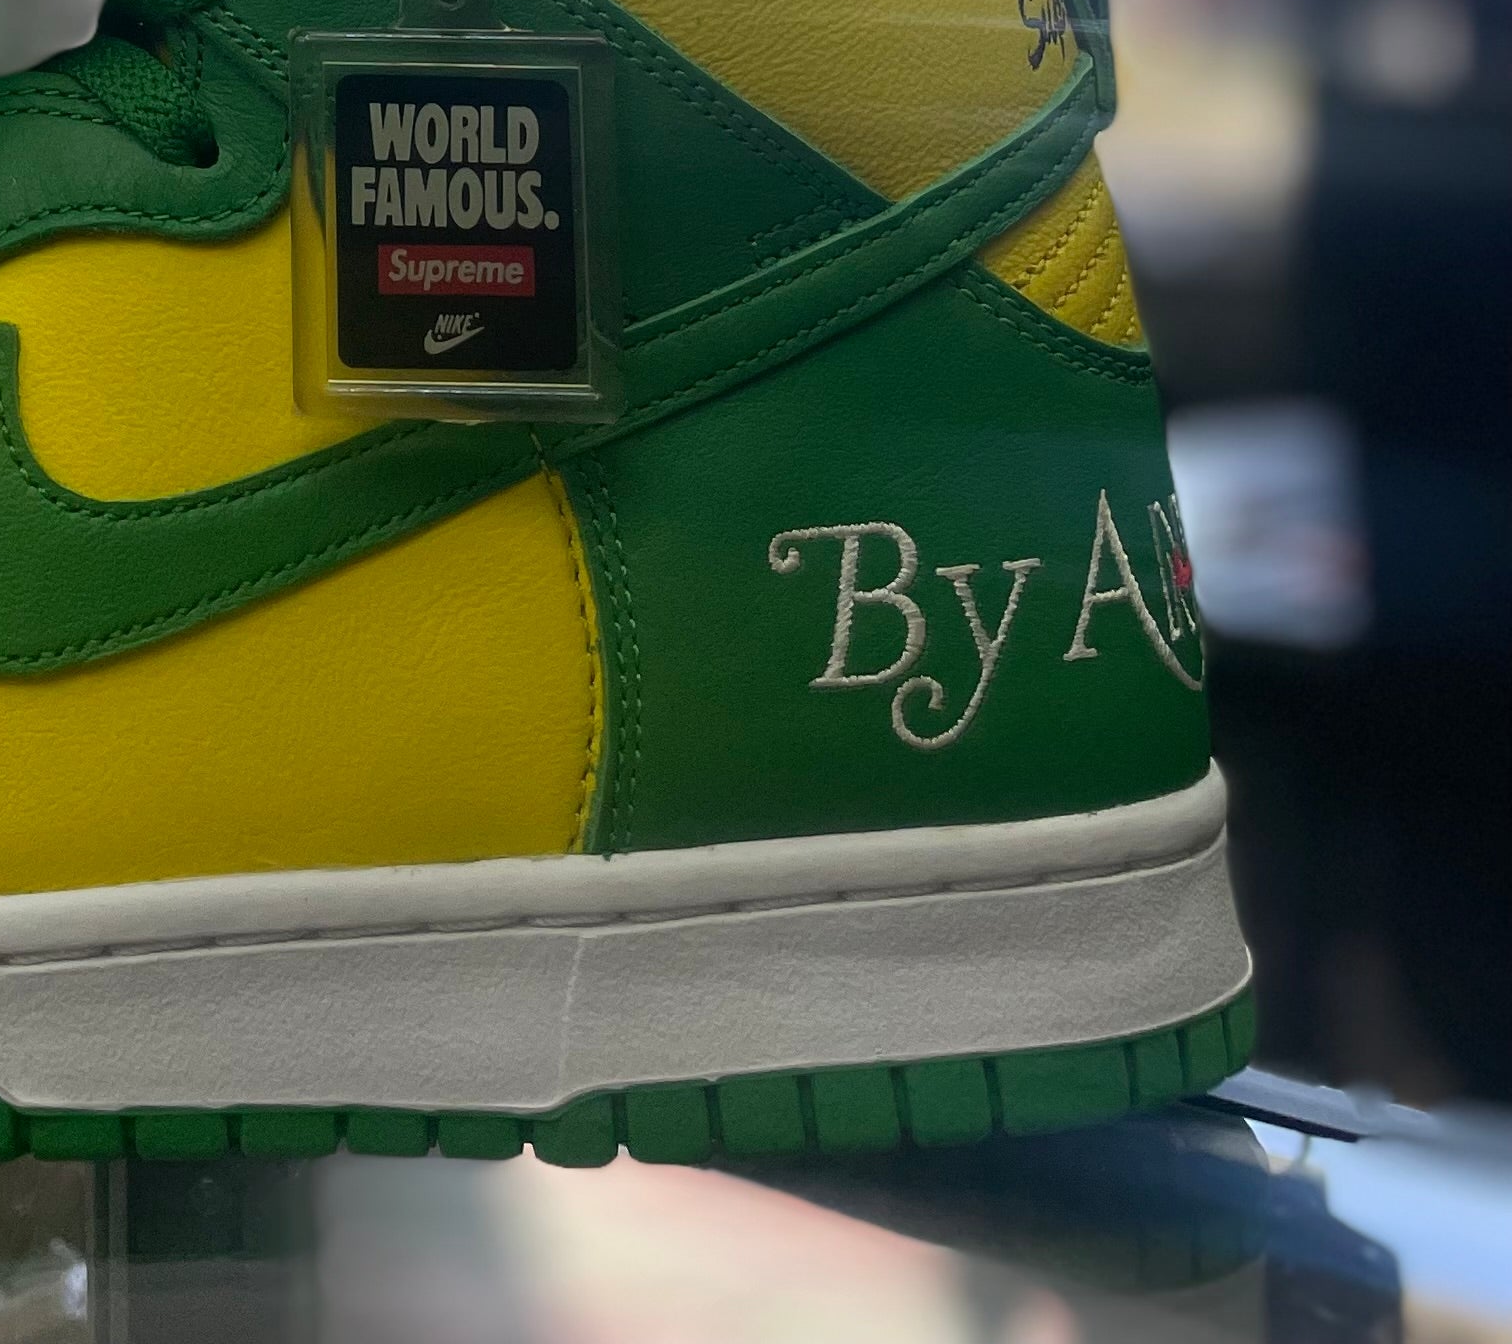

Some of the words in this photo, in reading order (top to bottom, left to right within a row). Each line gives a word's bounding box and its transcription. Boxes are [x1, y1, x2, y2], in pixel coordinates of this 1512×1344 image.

[369, 102, 540, 165] WORLD
[350, 165, 560, 230] FAMOUS.
[387, 248, 525, 291] Supreme
